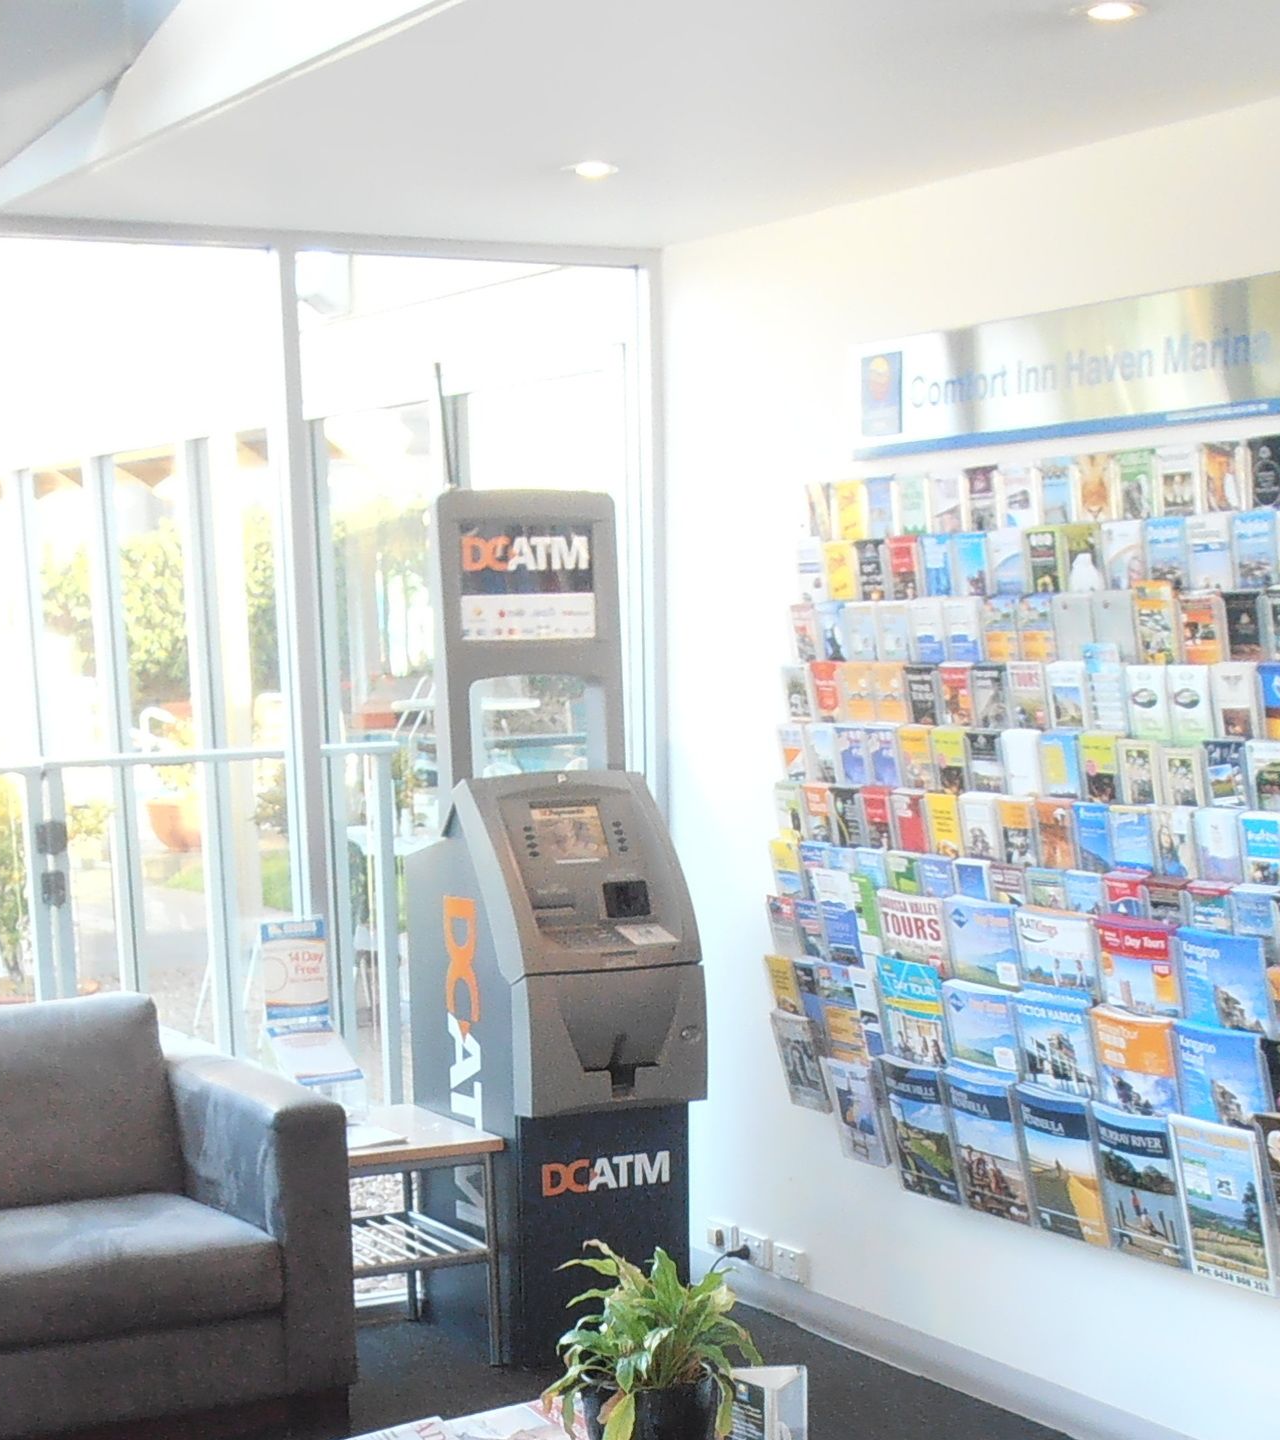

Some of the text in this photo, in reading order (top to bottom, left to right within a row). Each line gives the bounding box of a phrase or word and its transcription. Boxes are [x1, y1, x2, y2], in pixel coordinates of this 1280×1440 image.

[910, 328, 1271, 408] Comfort Inn Haven Marina
[461, 534, 590, 573] DCATM
[882, 911, 942, 942] TOURS
[1124, 934, 1142, 949] Day
[1142, 935, 1166, 949] Tours
[301, 950, 325, 965] Day
[1017, 1003, 1047, 1017] VICTOR
[1131, 1135, 1163, 1149] RIVER
[542, 1150, 670, 1197] DCATM
